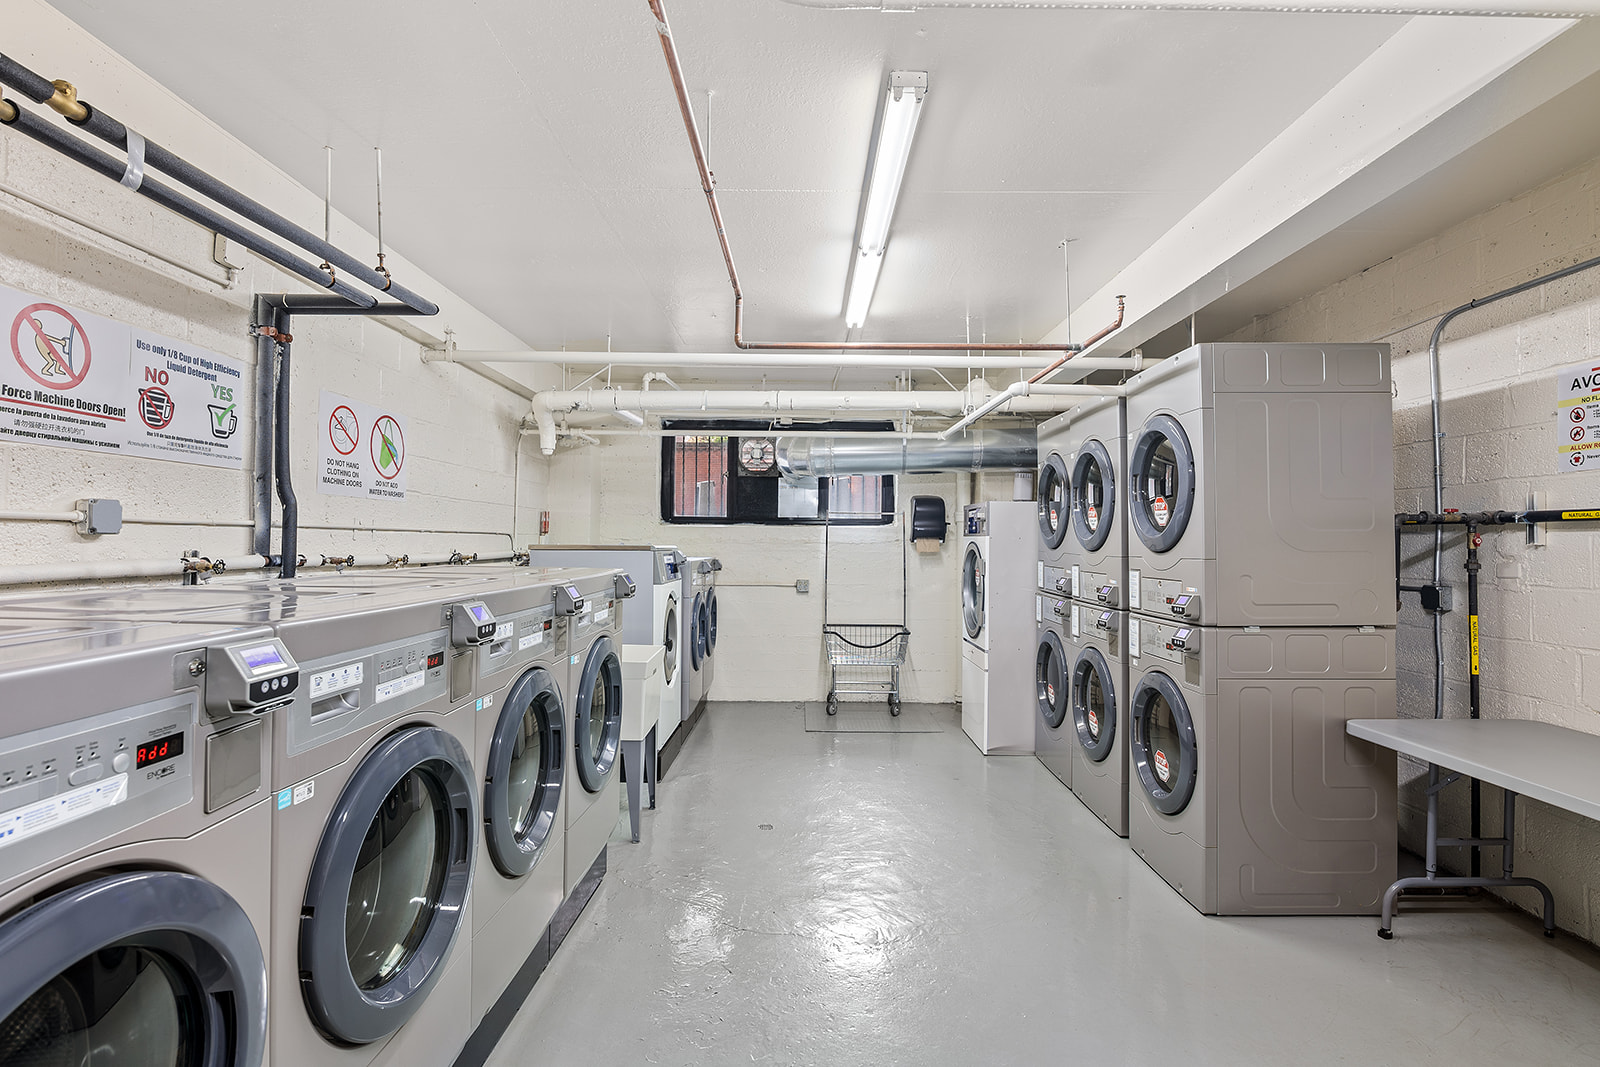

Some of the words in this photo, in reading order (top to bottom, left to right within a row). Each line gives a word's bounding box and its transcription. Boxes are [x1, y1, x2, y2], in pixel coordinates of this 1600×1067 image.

[137, 339, 150, 351] Use
[152, 345, 166, 356] only
[168, 349, 178, 359] 1/8
[179, 352, 191, 363] Cup
[193, 357, 199, 366] of
[200, 358, 213, 370] High
[214, 363, 240, 378] Efficiency
[145, 366, 169, 385] NO
[167, 360, 186, 373] Liquid
[188, 366, 217, 382] Detergent
[2, 384, 32, 400] Force
[34, 390, 75, 408] Machine
[76, 399, 102, 413] Doors
[103, 404, 126, 417] Open!
[211, 384, 233, 402] YES
[23, 410, 42, 418] puerta
[327, 468, 351, 477] CLOTHING
[323, 477, 345, 485] MACHINE
[346, 479, 362, 488] DOORS
[147, 763, 175, 780] ENCORE
